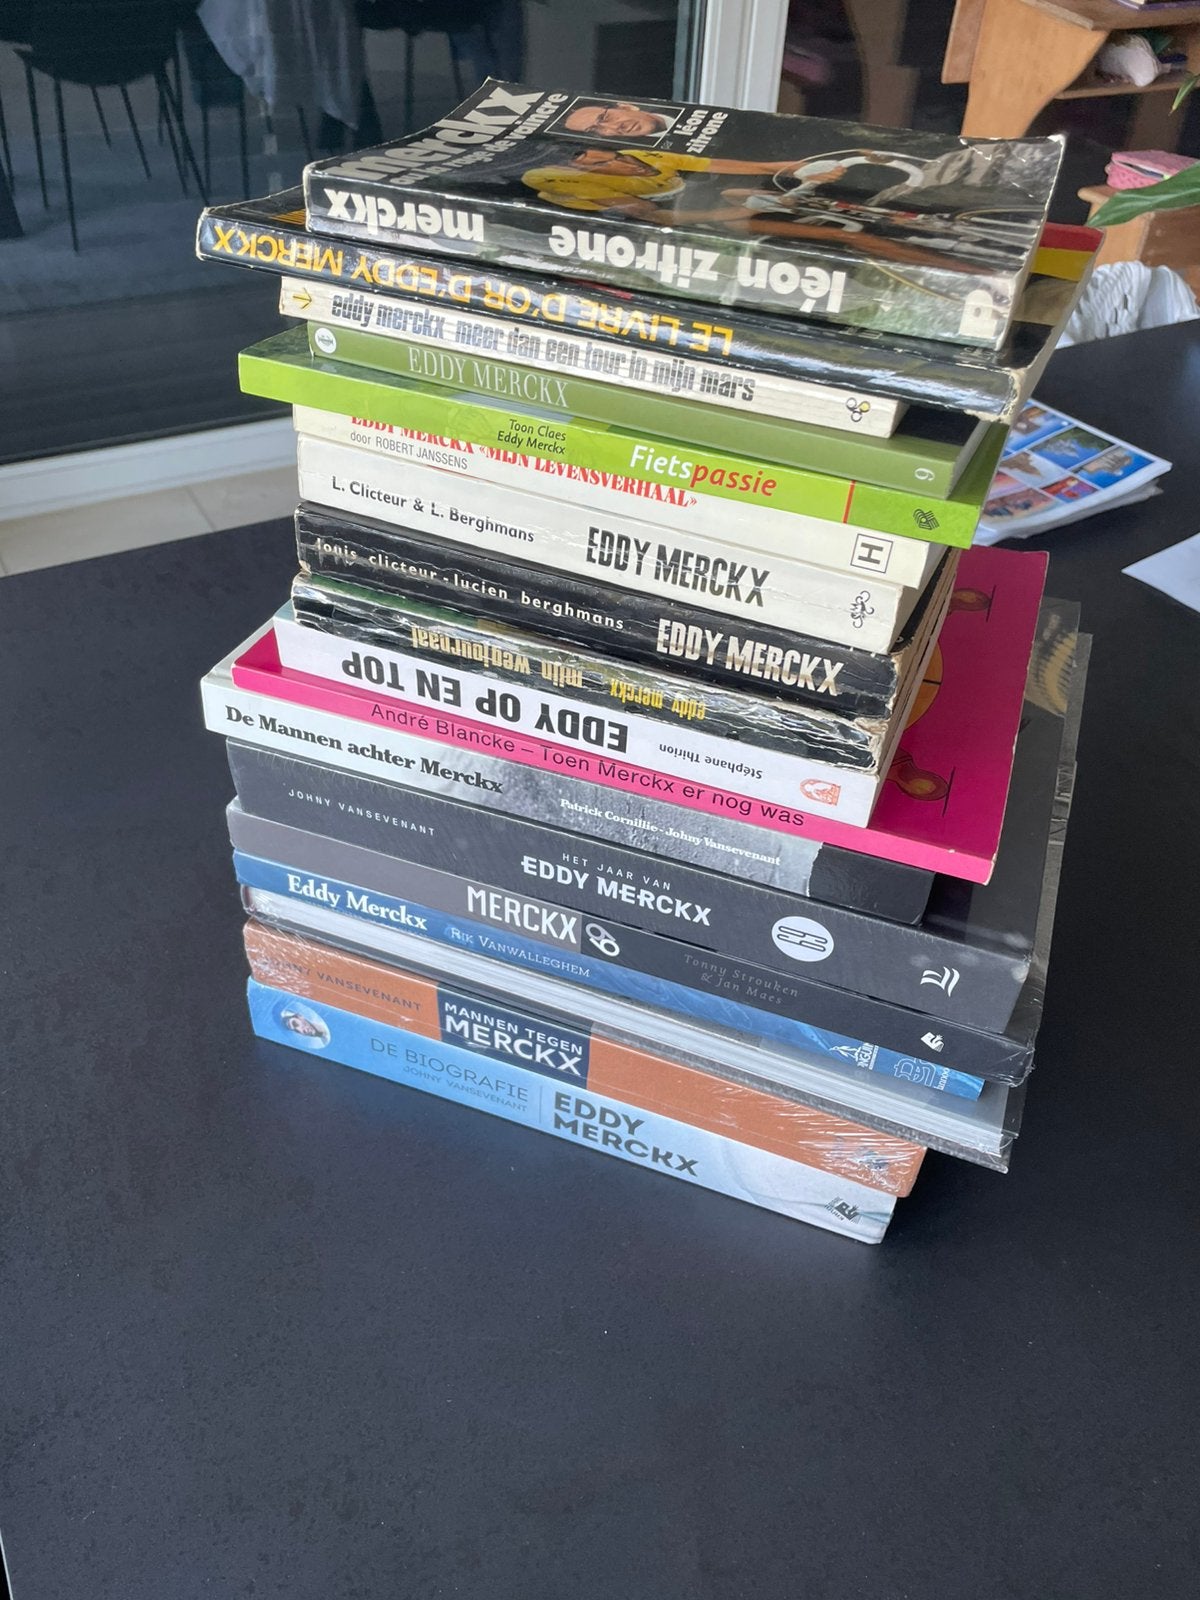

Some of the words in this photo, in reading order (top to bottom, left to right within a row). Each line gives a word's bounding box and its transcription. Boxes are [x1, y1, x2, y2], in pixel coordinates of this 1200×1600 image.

[326, 86, 545, 181] merckx
[389, 172, 430, 186] ou
[410, 165, 452, 175] la
[504, 93, 569, 140] vaincre
[673, 109, 709, 136] léon
[685, 111, 729, 154] zitrone
[323, 188, 485, 242] merckx
[212, 225, 344, 277] MERCKX
[548, 225, 721, 289] zitrone
[351, 255, 472, 303] D'EDDY
[484, 280, 567, 322] D'OR
[737, 256, 847, 313] léon
[331, 293, 375, 328] eddy
[375, 303, 446, 340] merckx
[455, 319, 505, 350] meer
[507, 327, 541, 360] dan
[544, 338, 580, 367] een
[584, 341, 627, 376] tour
[628, 350, 648, 381] in
[652, 358, 696, 393] mijn
[699, 368, 756, 401] mars
[576, 299, 680, 345] LIVRE
[689, 321, 734, 356] LE
[408, 346, 467, 385] EDDY
[472, 360, 570, 408] MERCKX
[350, 430, 371, 445] door
[375, 436, 414, 457] ROBERT
[416, 447, 469, 470] JANSSENS
[497, 430, 524, 449] Eddy
[526, 437, 566, 455] Merckx
[509, 418, 534, 435] Toon
[537, 425, 567, 441] Claes
[629, 444, 778, 497] Fietspassie
[332, 475, 345, 492] L.
[349, 481, 407, 509] Clicteur
[413, 499, 424, 513] &
[431, 502, 445, 518] L.
[449, 508, 535, 543] Berghmans
[315, 538, 358, 561] louis
[521, 592, 625, 630] berghmans
[586, 525, 652, 576] EDDY
[654, 544, 770, 607] MERCKX
[341, 651, 405, 692] TOP
[656, 618, 724, 666] EDDY
[725, 635, 845, 696] MERCKX
[416, 669, 462, 708] EN
[475, 688, 522, 723] OP
[609, 678, 663, 710] merckx
[671, 697, 706, 721] eddy
[225, 704, 255, 727] De
[258, 713, 343, 751] Mannen
[347, 741, 416, 769] achter
[419, 757, 504, 795] Merckx
[535, 703, 629, 754] EDDY
[659, 743, 701, 764] Thirion
[371, 703, 429, 731] André
[436, 720, 516, 753] Blancke
[540, 744, 590, 771] Toen
[598, 759, 675, 793] Merckx
[682, 785, 705, 800] er
[711, 792, 752, 816] nog
[760, 805, 805, 826] was
[704, 755, 763, 780] Stéphane
[288, 788, 332, 808] JOHNY
[338, 802, 435, 836] VANSEVENANT
[559, 798, 603, 818] Patrick
[604, 810, 658, 832] Cornillie
[665, 827, 704, 845] Johny
[703, 836, 782, 866] Vansevenant
[521, 855, 590, 890] EDDY
[596, 876, 712, 927] MERCKX
[562, 853, 589, 867] HET
[596, 863, 634, 881] JAAR
[642, 875, 672, 891] VAN
[286, 873, 341, 908] Eddy
[345, 890, 428, 931] Merckx
[466, 885, 578, 944] MERCKX
[316, 970, 422, 1012] VANSEVENANT
[684, 953, 727, 977] Tonny
[732, 969, 799, 998] Strouken
[700, 972, 713, 984] &
[715, 977, 740, 992] Jan
[444, 1001, 518, 1035] MANNEN
[524, 1027, 583, 1056] TEGEN
[445, 1014, 582, 1077] MERCKX
[370, 1037, 398, 1058] DE
[405, 1048, 529, 1102] BIOGRAFIE
[402, 1065, 442, 1084] JOHNY
[445, 1079, 528, 1112] VANSEVENANT
[554, 1090, 645, 1136] EDDY
[553, 1112, 699, 1177] MERCKX
